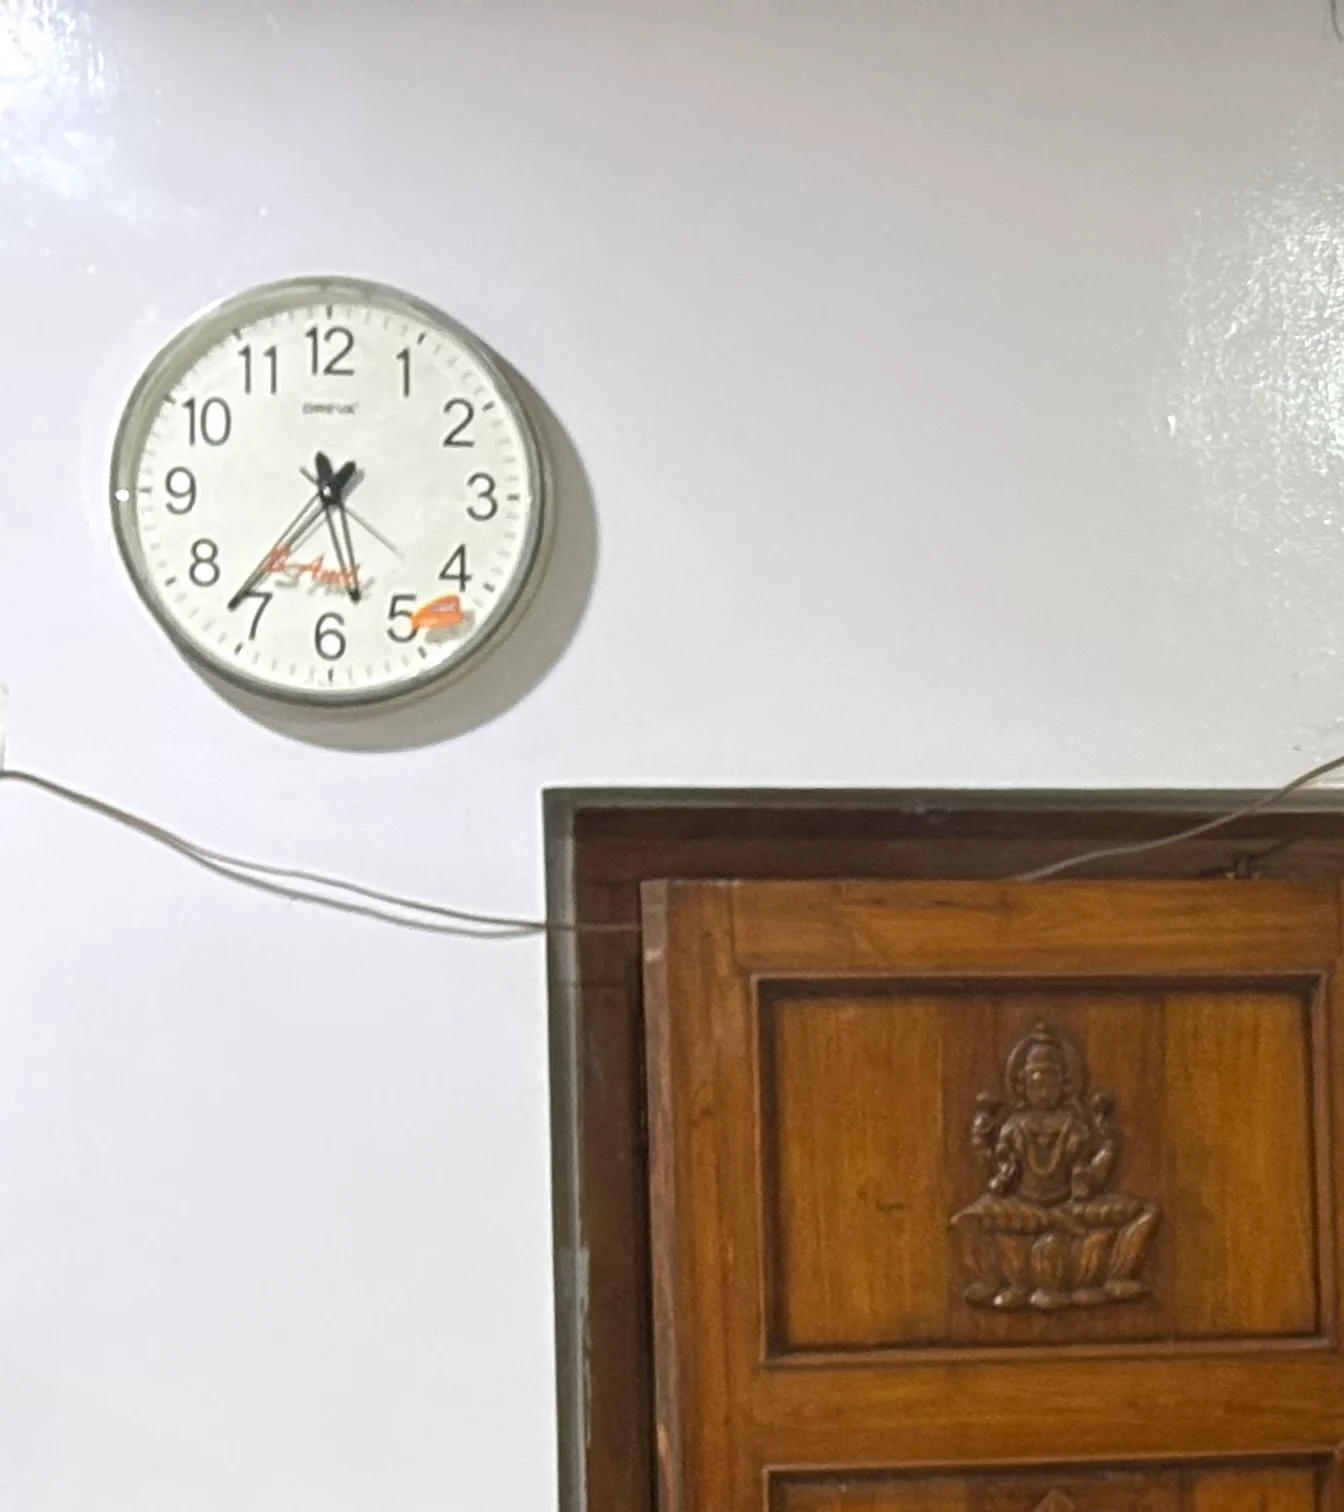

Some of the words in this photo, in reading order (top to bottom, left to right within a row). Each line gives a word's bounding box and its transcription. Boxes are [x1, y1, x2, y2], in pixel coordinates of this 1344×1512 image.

[237, 344, 278, 395] 11
[304, 325, 355, 377] 12
[396, 347, 411, 398] 1
[181, 396, 232, 447] 10
[442, 397, 475, 448] 2
[164, 466, 197, 516] 9
[466, 471, 499, 522] 3
[188, 537, 221, 588] 8
[438, 543, 473, 593] 4
[242, 589, 274, 641] 7
[313, 611, 347, 662] 6
[386, 593, 421, 644] 5
